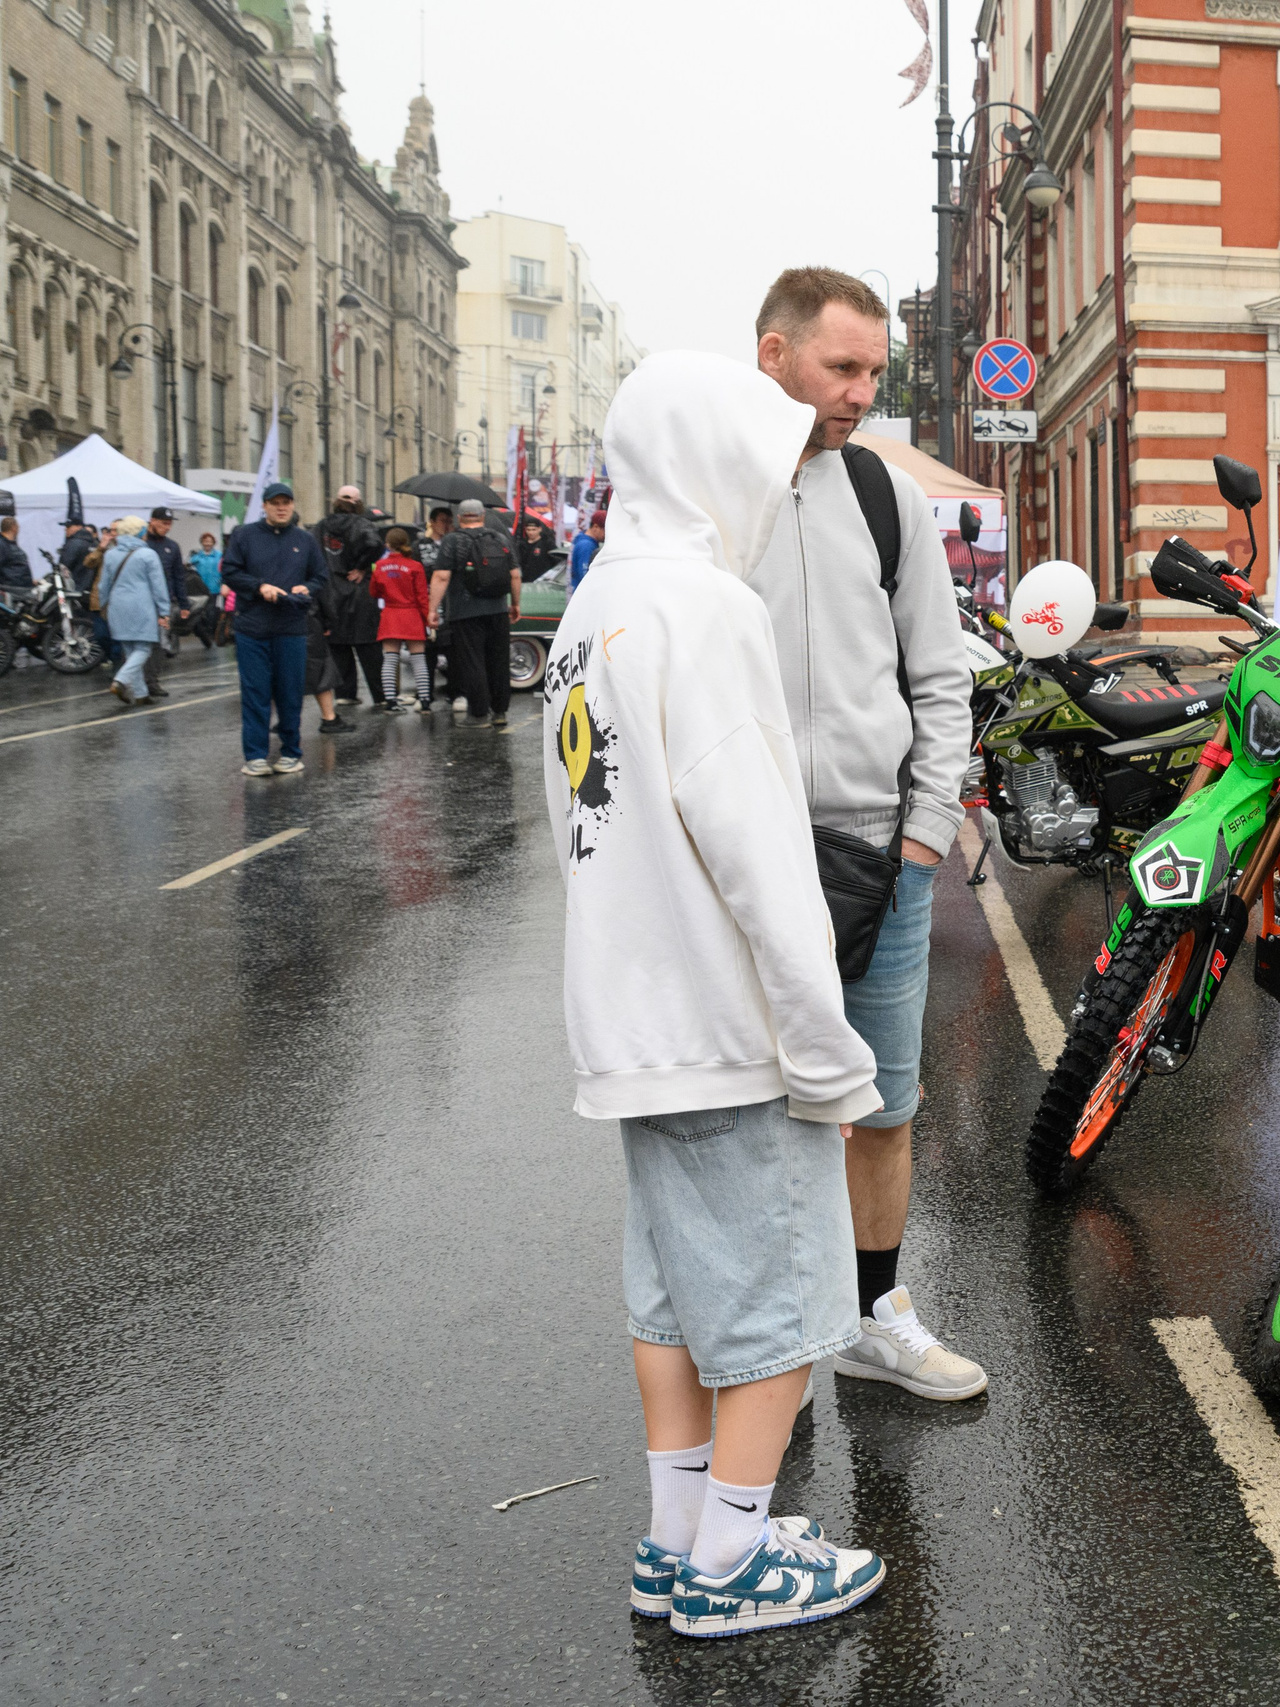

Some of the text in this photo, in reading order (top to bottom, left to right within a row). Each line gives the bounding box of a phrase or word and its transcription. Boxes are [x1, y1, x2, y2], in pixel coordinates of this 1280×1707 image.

[1185, 700, 1209, 716] SPR
[1228, 814, 1248, 834] SPR
[1094, 902, 1133, 976] SPR
